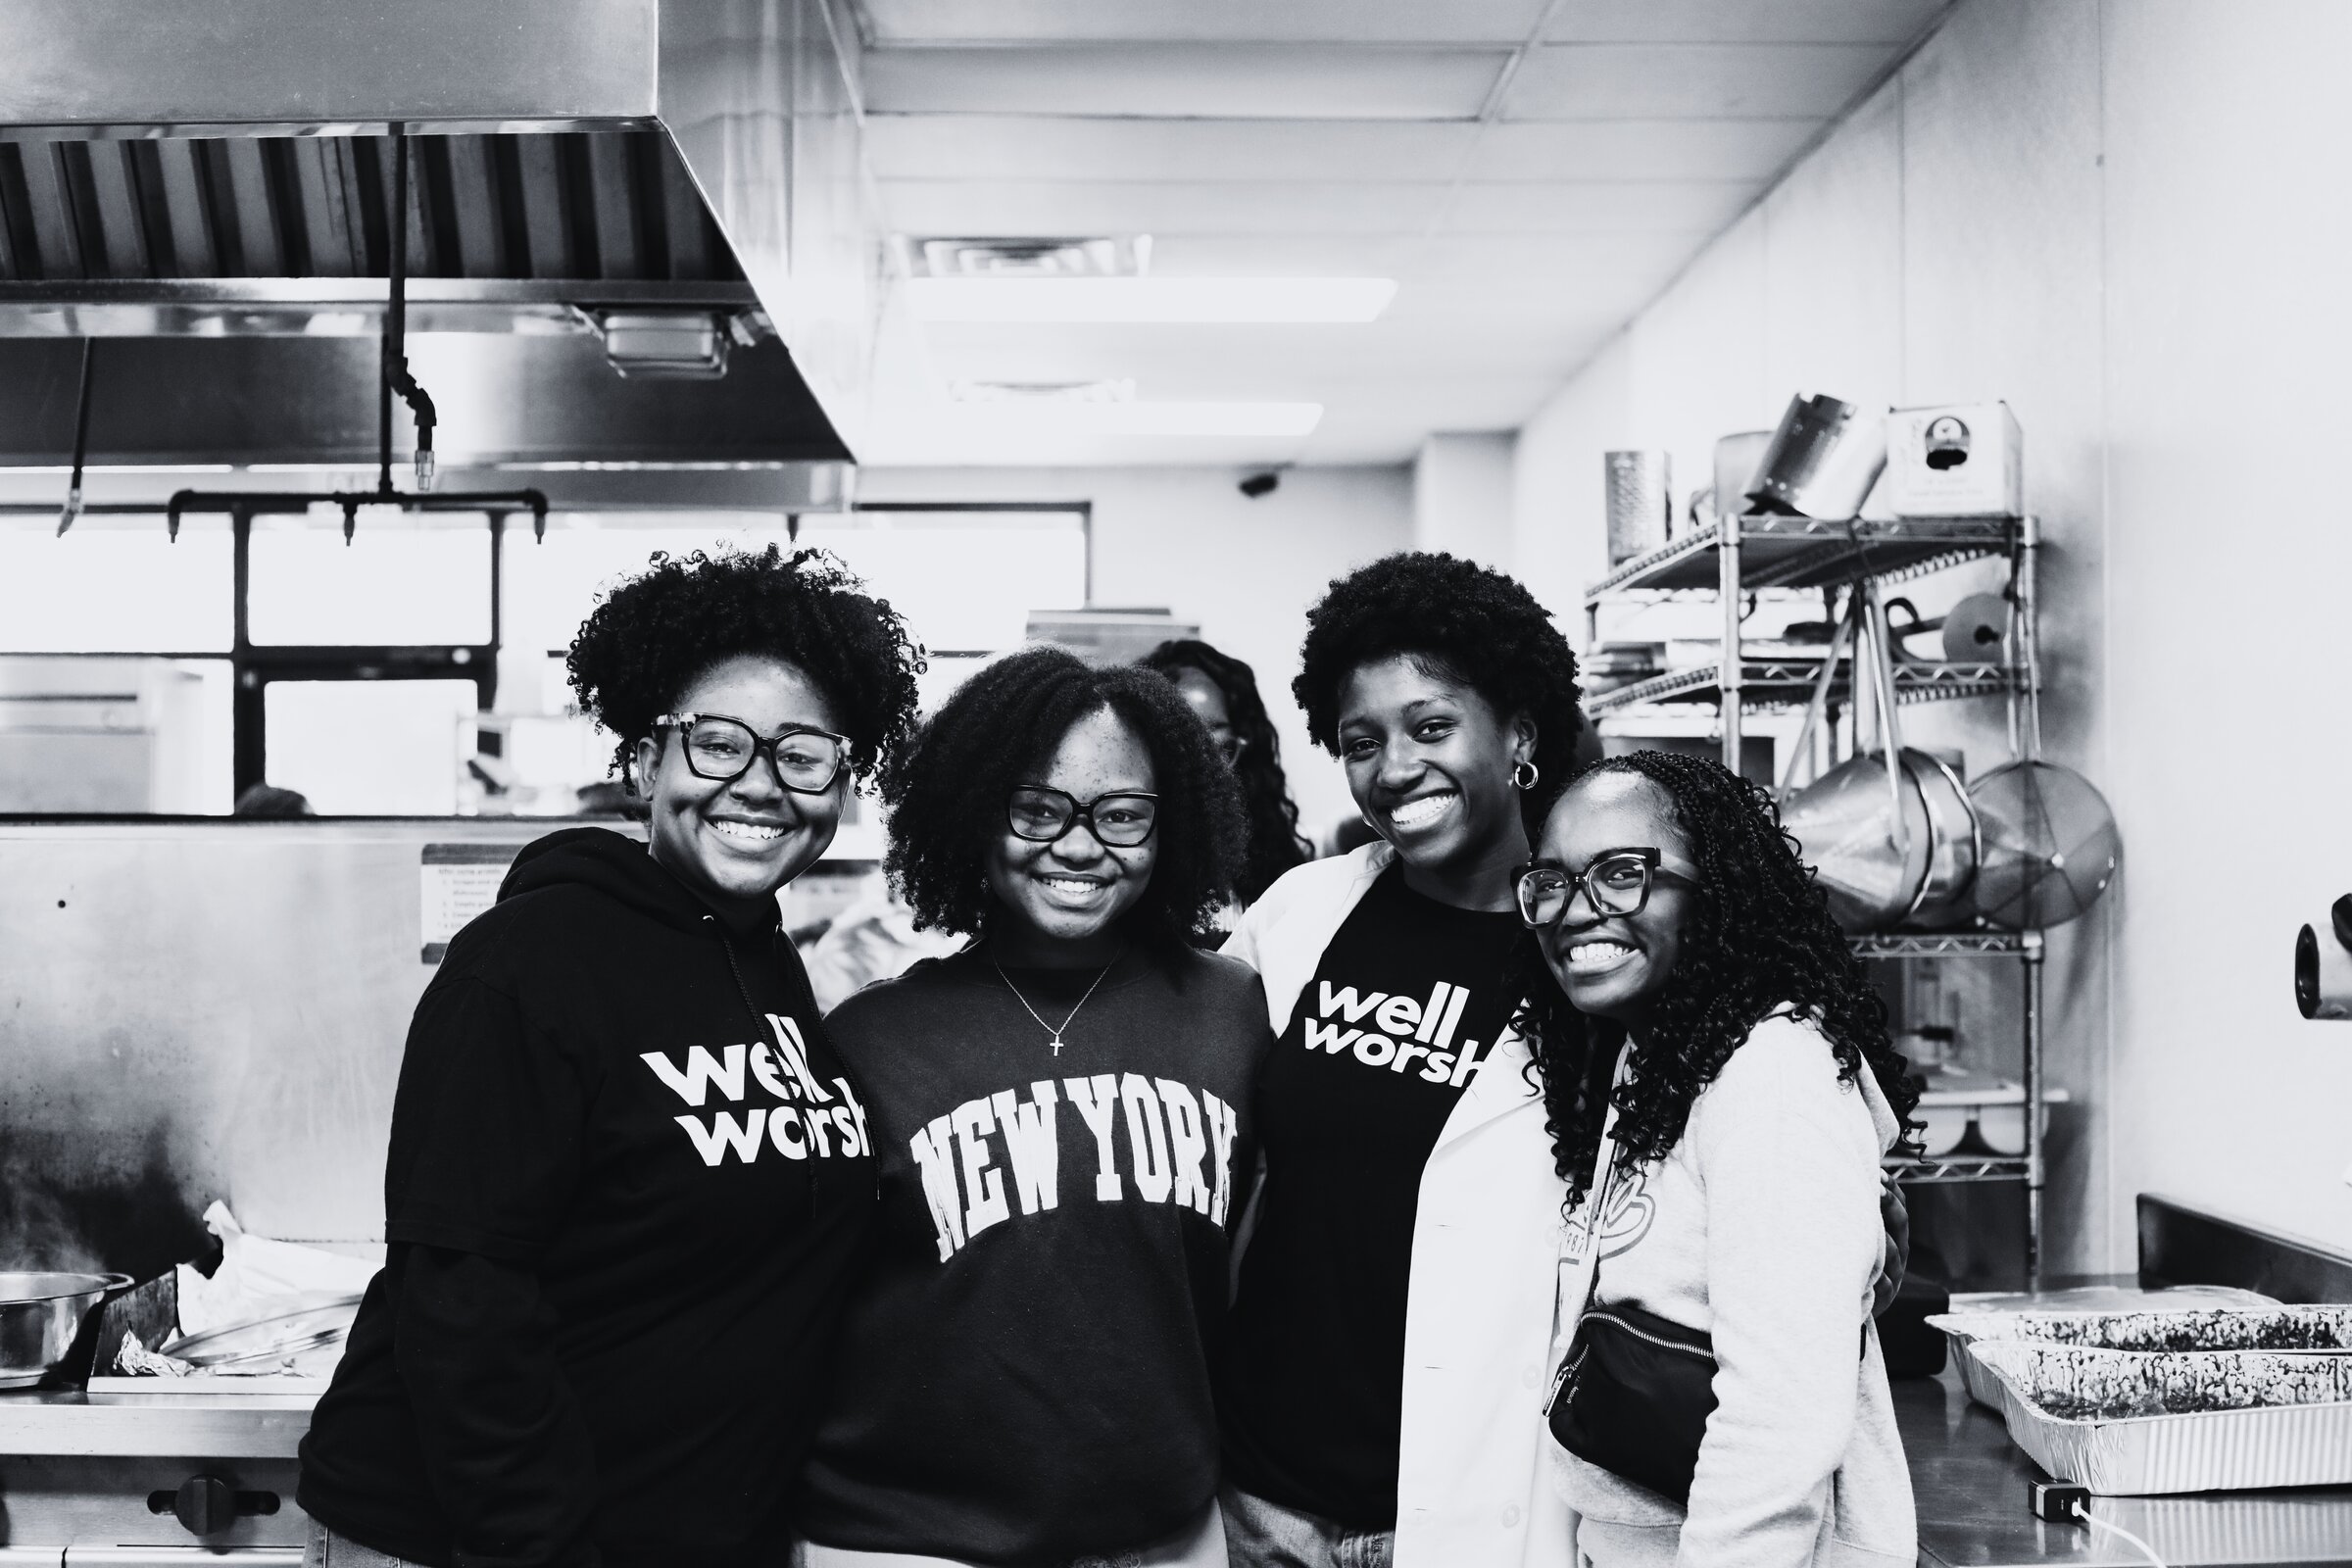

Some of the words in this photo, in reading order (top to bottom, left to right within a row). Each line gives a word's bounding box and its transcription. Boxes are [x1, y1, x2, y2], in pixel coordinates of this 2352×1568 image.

[639, 1013, 834, 1106] well
[1319, 980, 1470, 1050] well
[909, 1079, 1058, 1263] NEW
[1063, 1072, 1238, 1231] YORK
